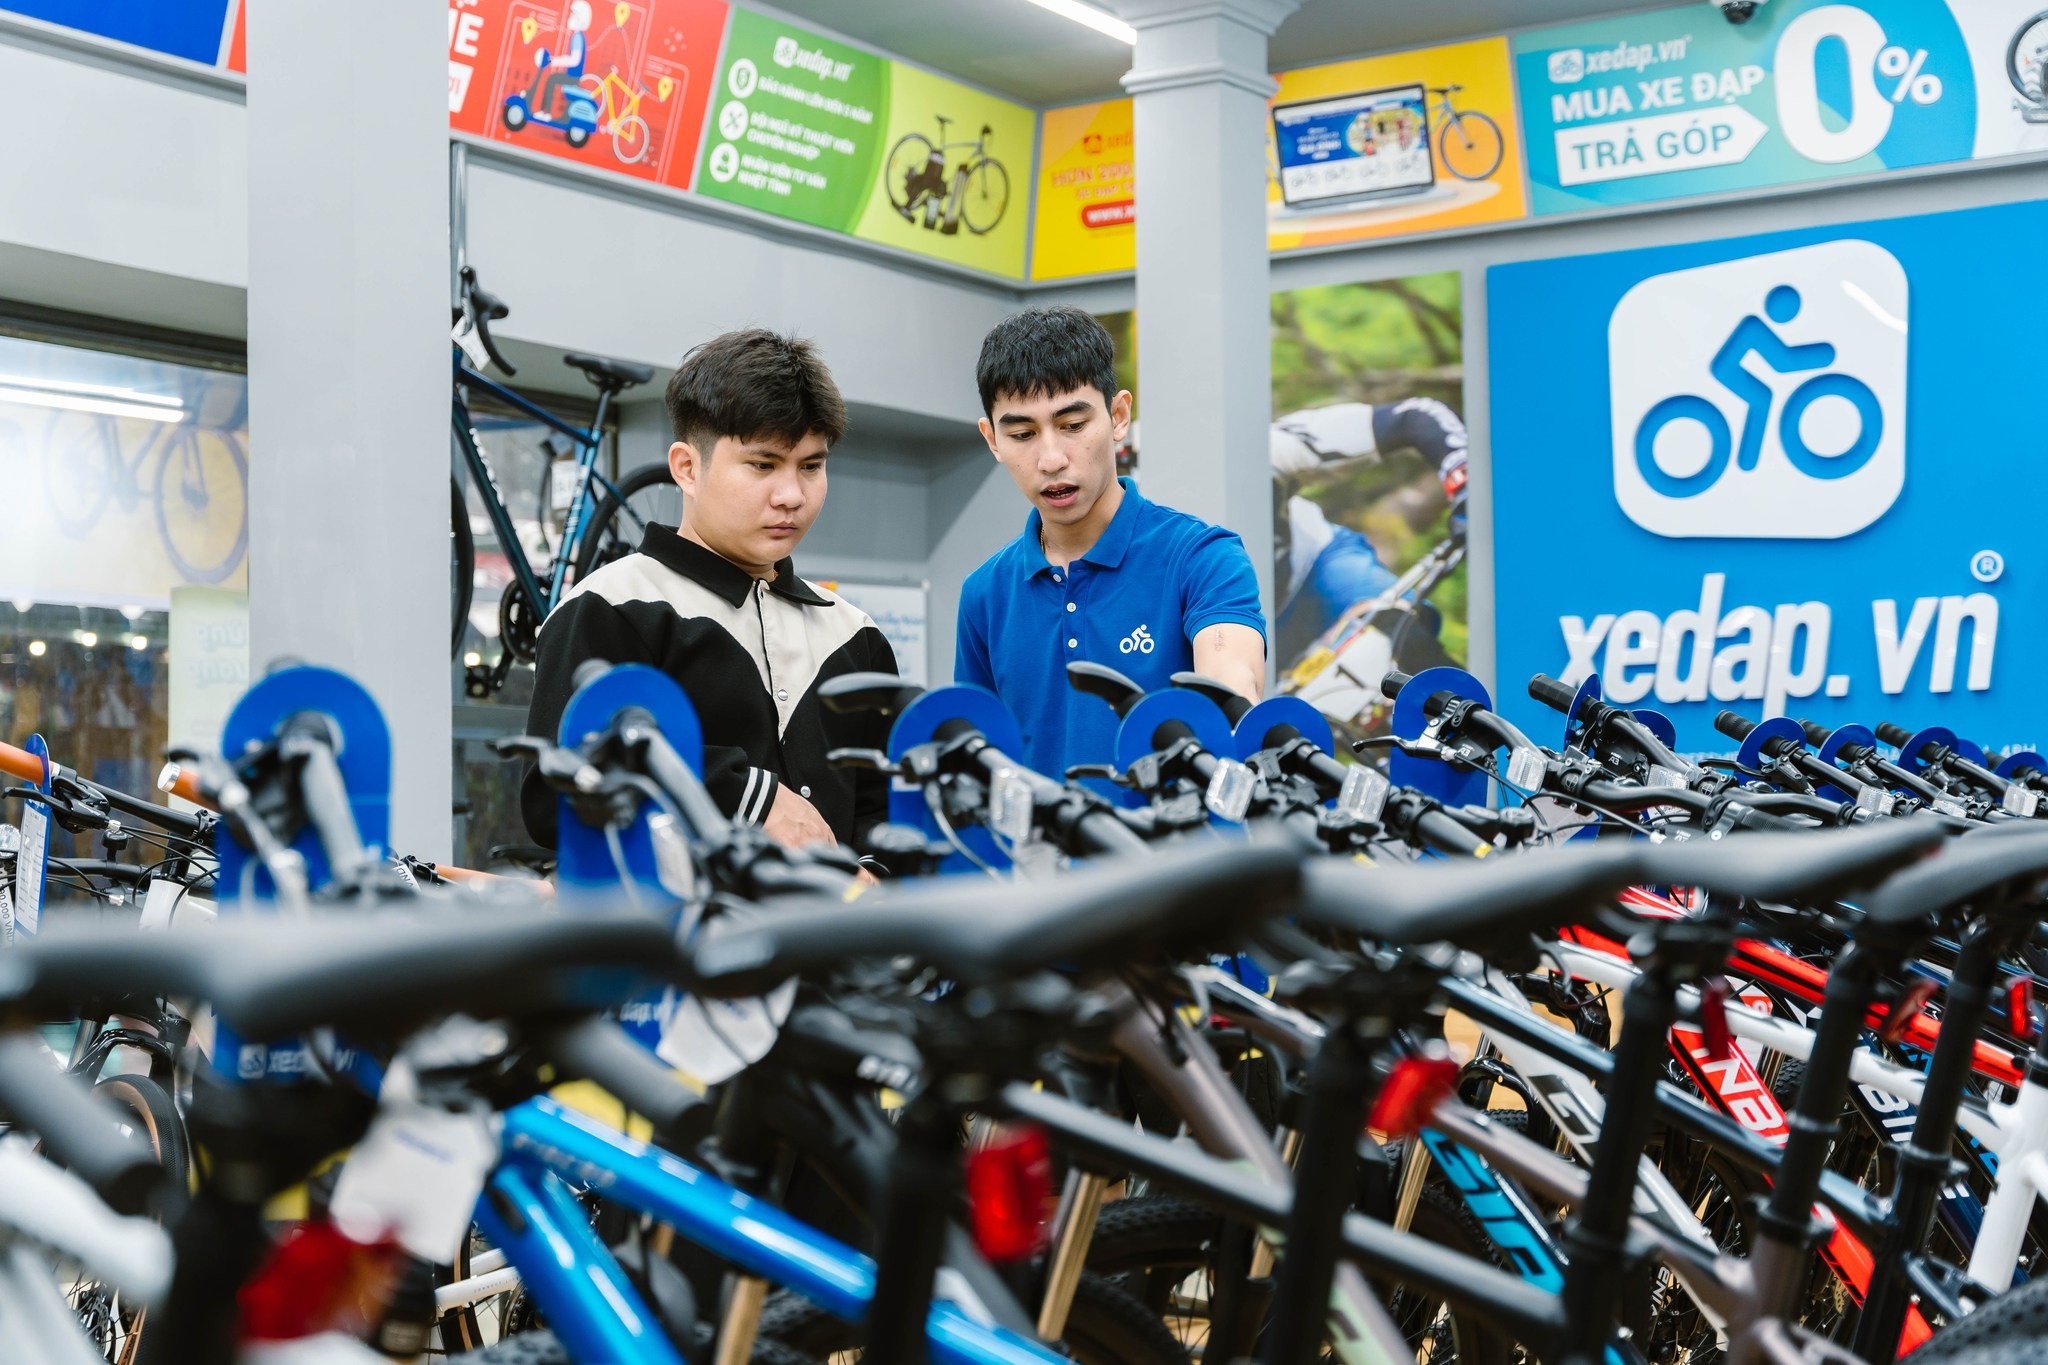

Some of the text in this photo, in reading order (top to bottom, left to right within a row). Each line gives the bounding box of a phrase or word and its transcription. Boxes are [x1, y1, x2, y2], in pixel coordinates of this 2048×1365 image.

[1585, 37, 1687, 74] xedap.vn
[1551, 64, 1765, 123] MUA XE ĐẠP
[1773, 4, 1943, 165] 0%
[1572, 118, 1733, 171] TRẢ GÓP
